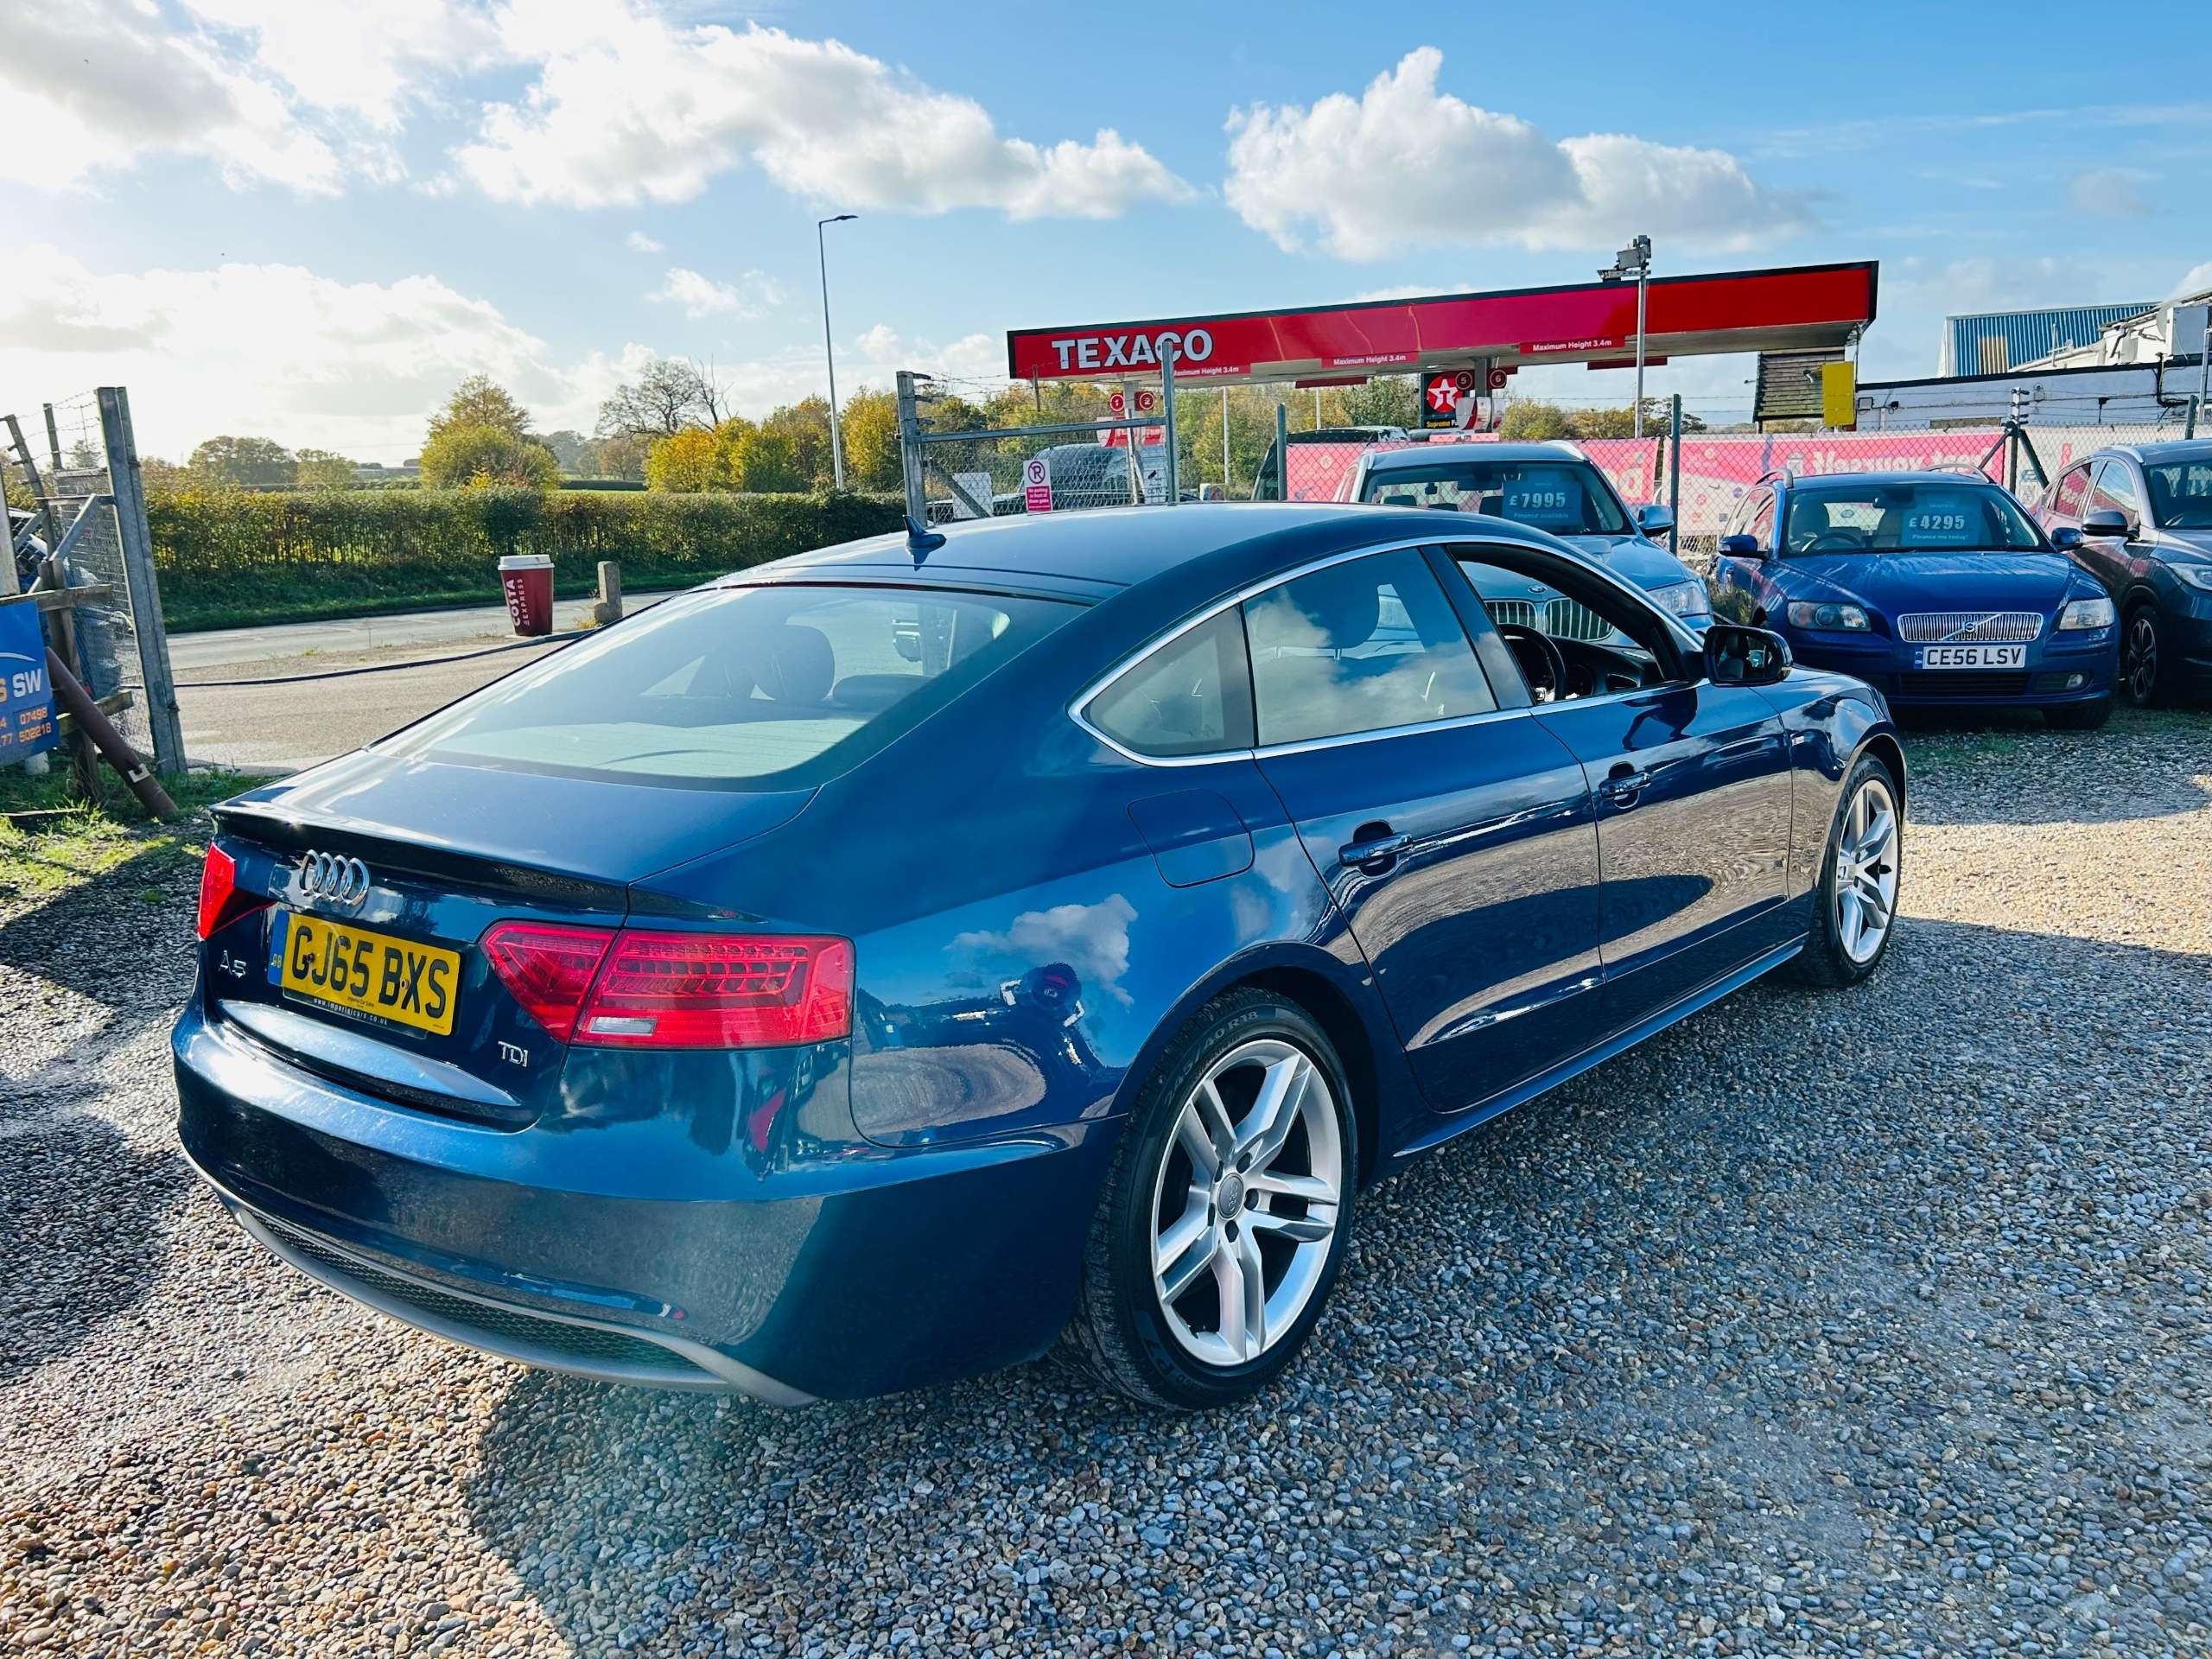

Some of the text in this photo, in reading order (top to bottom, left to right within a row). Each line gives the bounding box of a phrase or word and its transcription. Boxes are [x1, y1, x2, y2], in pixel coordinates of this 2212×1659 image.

[1051, 328, 1213, 370] TEXACO
[1567, 340, 1592, 350] Height
[1592, 339, 1612, 347] 3.4m
[1201, 366, 1222, 375] Height
[1365, 355, 1388, 364] Height
[506, 579, 521, 626] COSTA
[517, 579, 529, 620] EXPRESS
[1927, 648, 2022, 665] CE56 LSV
[12, 668, 42, 698] SW
[218, 950, 246, 979] A5
[291, 925, 450, 1020] GJ65 BXS
[498, 1040, 529, 1068] TDI
